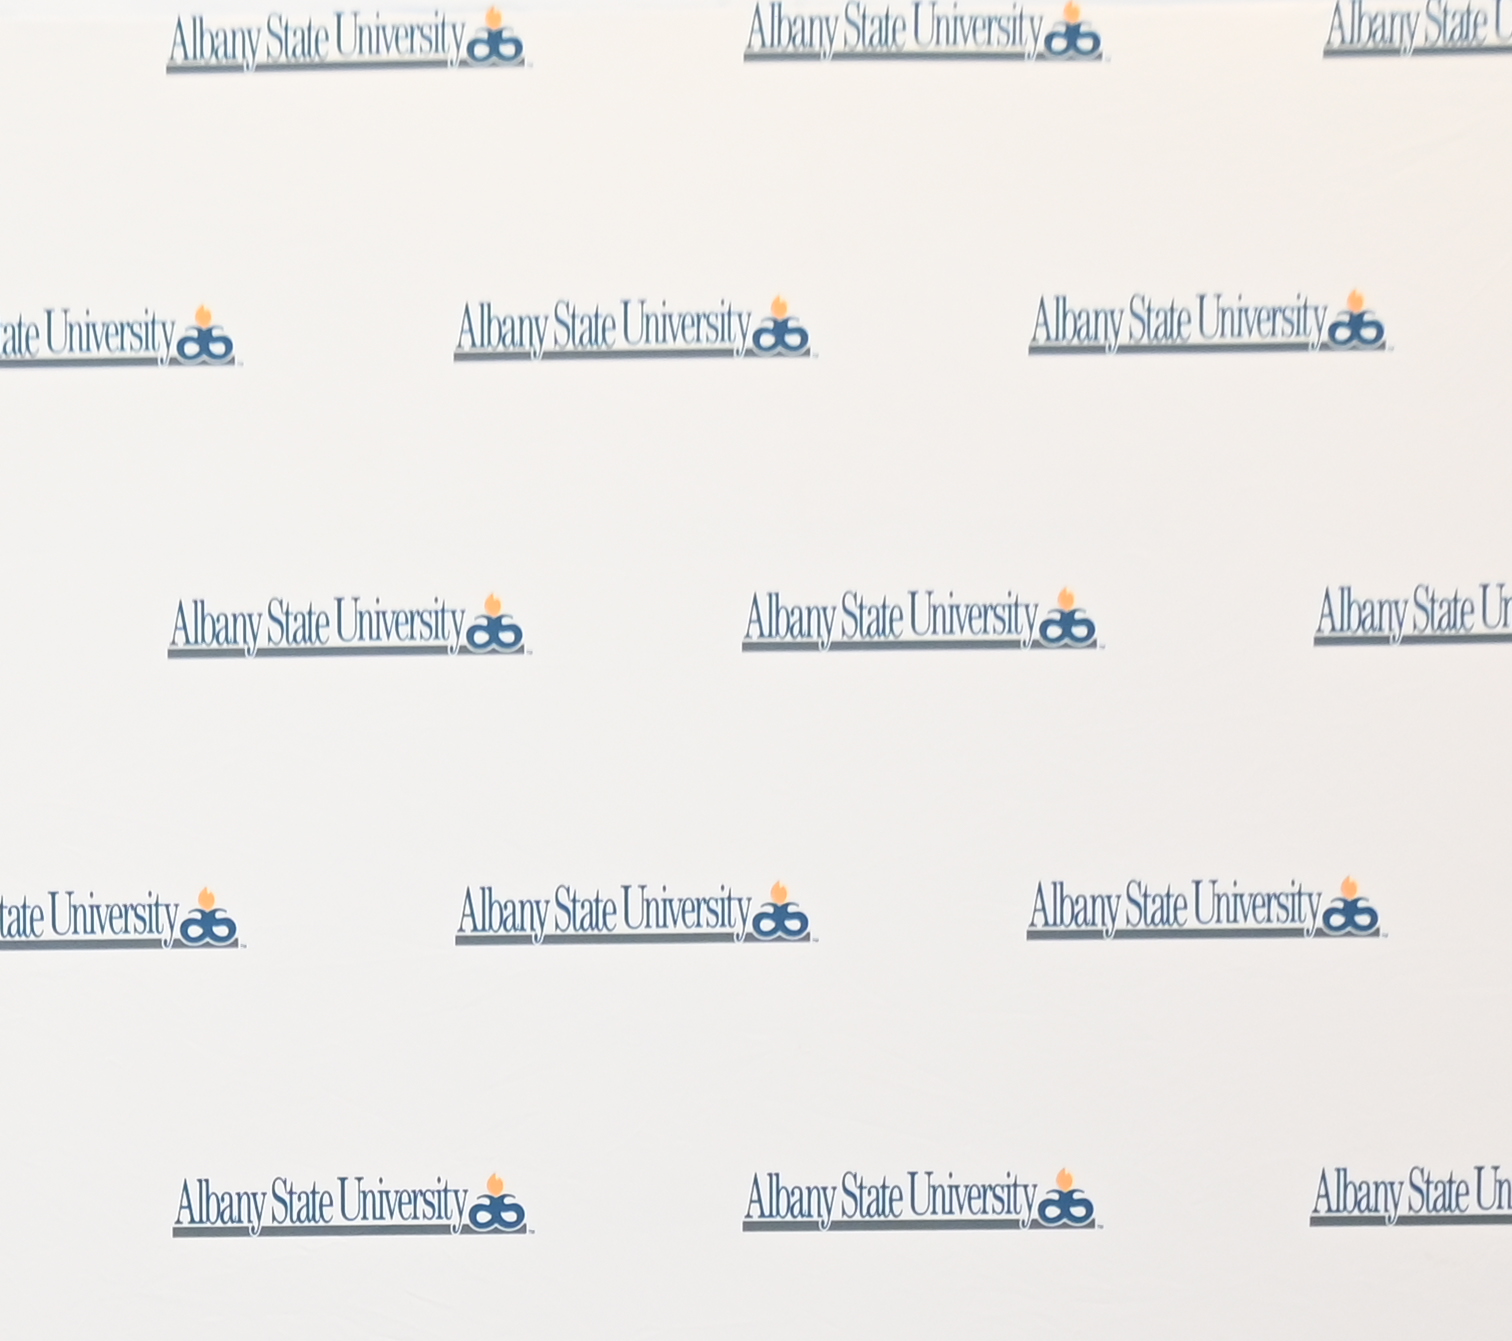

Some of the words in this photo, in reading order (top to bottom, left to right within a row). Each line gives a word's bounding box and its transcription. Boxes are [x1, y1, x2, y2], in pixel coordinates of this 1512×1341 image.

[168, 15, 262, 72] Albany
[266, 12, 330, 61] State
[334, 9, 466, 68] University
[746, 1, 840, 61] Albany
[843, 0, 907, 49] State
[912, 1, 1044, 61] University
[1326, 0, 1421, 56] Albany
[1423, 0, 1488, 44] State
[44, 307, 176, 366] University
[456, 301, 549, 360] Albany
[553, 299, 616, 349] State
[620, 298, 752, 358] University
[1031, 295, 1125, 354] Albany
[1128, 293, 1192, 342] State
[1196, 292, 1328, 351] University
[170, 599, 263, 657] Albany
[267, 596, 330, 646] State
[334, 596, 466, 655] University
[744, 592, 837, 650] Albany
[841, 589, 904, 639] State
[908, 589, 1039, 649] University
[1316, 586, 1409, 644] Albany
[1412, 583, 1475, 633] State
[48, 890, 180, 948] University
[458, 886, 550, 944] Albany
[554, 884, 617, 933] State
[621, 883, 752, 942] University
[1029, 880, 1121, 939] Albany
[1125, 878, 1188, 928] State
[1192, 878, 1322, 937] University
[175, 1178, 267, 1236] Albany
[271, 1176, 334, 1225] State
[337, 1175, 468, 1234] University
[745, 1172, 837, 1230] Albany
[841, 1170, 904, 1219] State
[907, 1170, 1038, 1229] University
[1312, 1167, 1404, 1225] Albany
[1407, 1165, 1470, 1214] State
